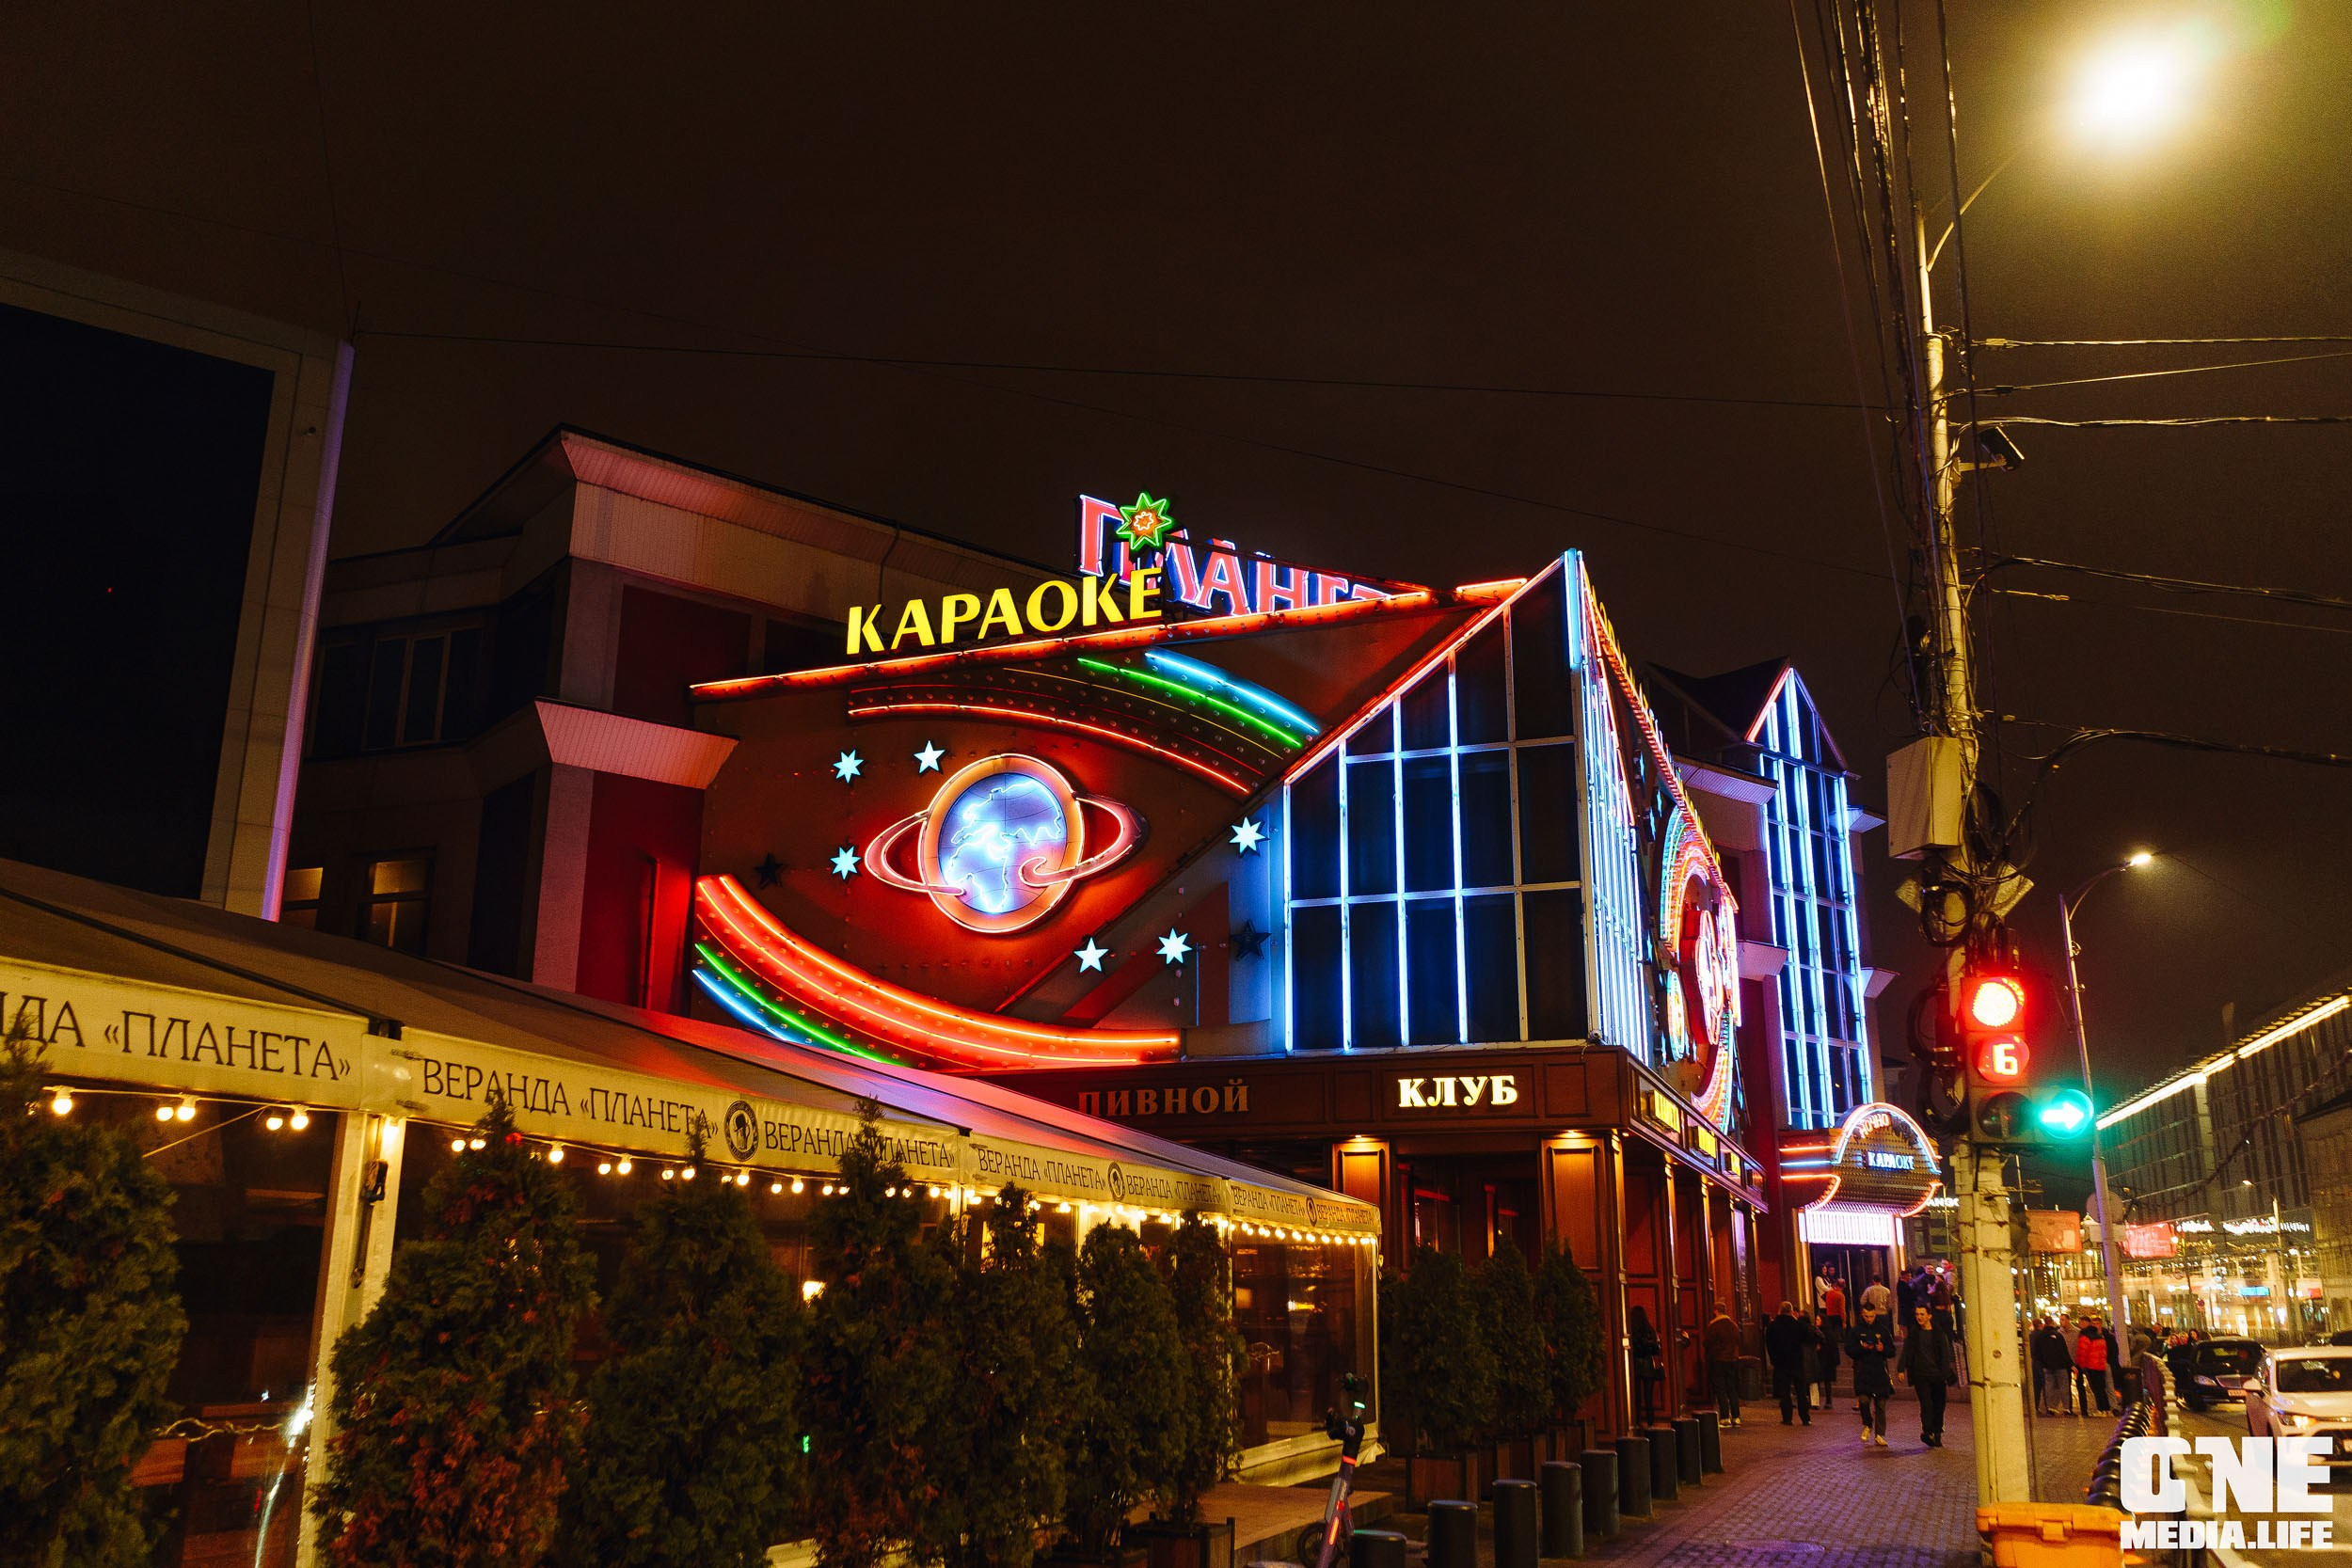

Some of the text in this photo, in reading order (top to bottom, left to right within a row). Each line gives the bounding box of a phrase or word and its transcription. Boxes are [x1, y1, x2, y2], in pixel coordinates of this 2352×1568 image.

[847, 567, 1163, 655] КАРАОКЕ
[104, 1009, 351, 1081] «ПЛАНЕТА»
[1993, 1044, 2018, 1075] 6
[423, 1058, 572, 1117] ВЕРАНДА
[1078, 1075, 1518, 1117] ПИВНОЙ КЛУБ
[978, 1148, 1106, 1191] ВЕРАНДА «ПЛАНЕТА»
[1126, 1175, 1173, 1200] ВЕРАНДА
[1233, 1187, 1269, 1211] ВЕРАНДА
